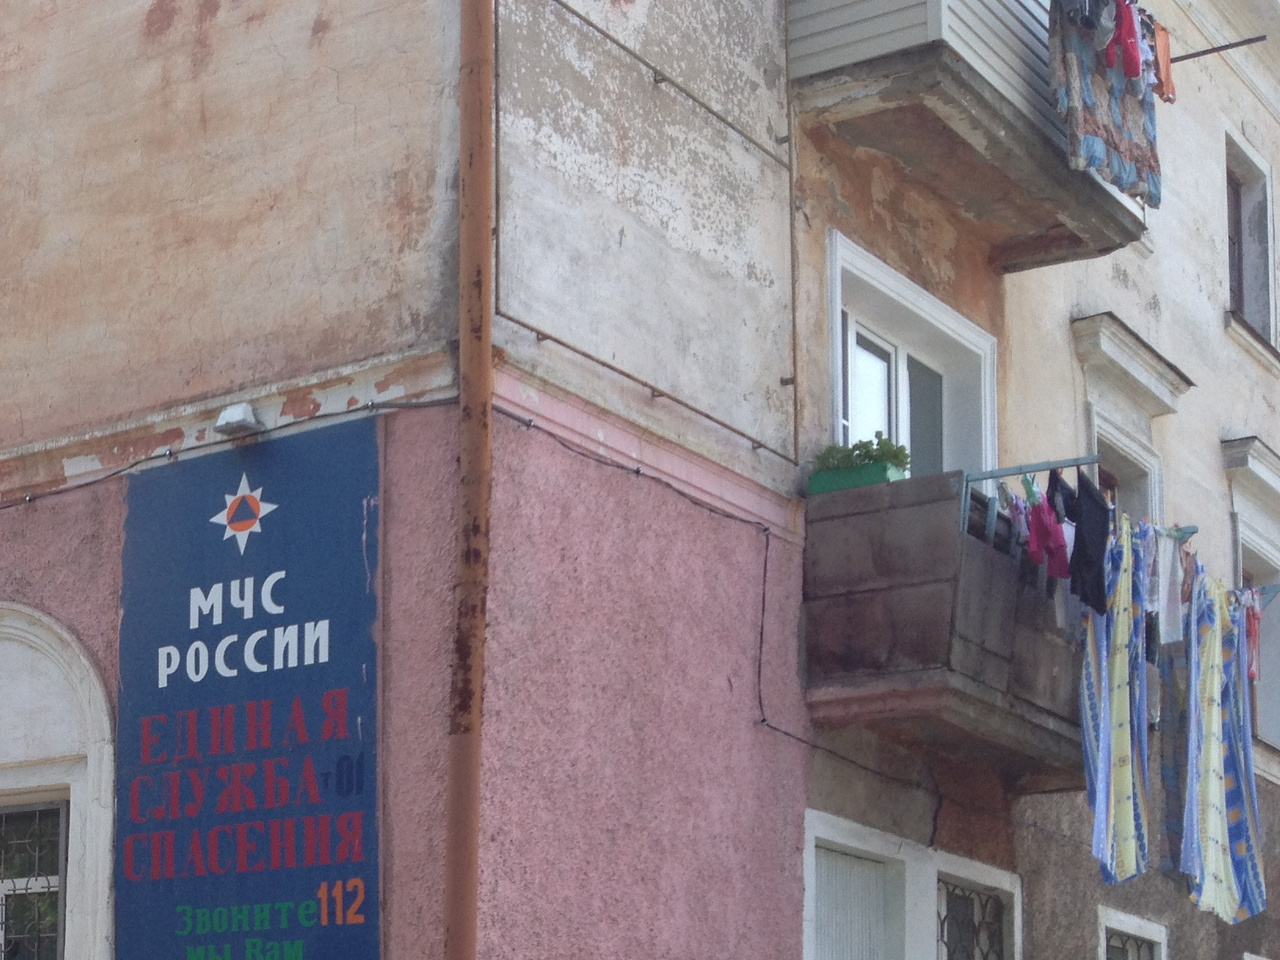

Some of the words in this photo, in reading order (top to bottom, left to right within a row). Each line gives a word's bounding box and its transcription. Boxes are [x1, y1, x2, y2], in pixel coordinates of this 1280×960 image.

[190, 570, 286, 629] МЧС
[158, 619, 329, 688] РОССИИ
[139, 687, 351, 766] ЕДИНАЯ
[129, 755, 323, 823] СЛУЖБА
[123, 811, 366, 881] СПАСЕНИЯ
[175, 900, 318, 936] Звоните
[317, 877, 366, 926] 112
